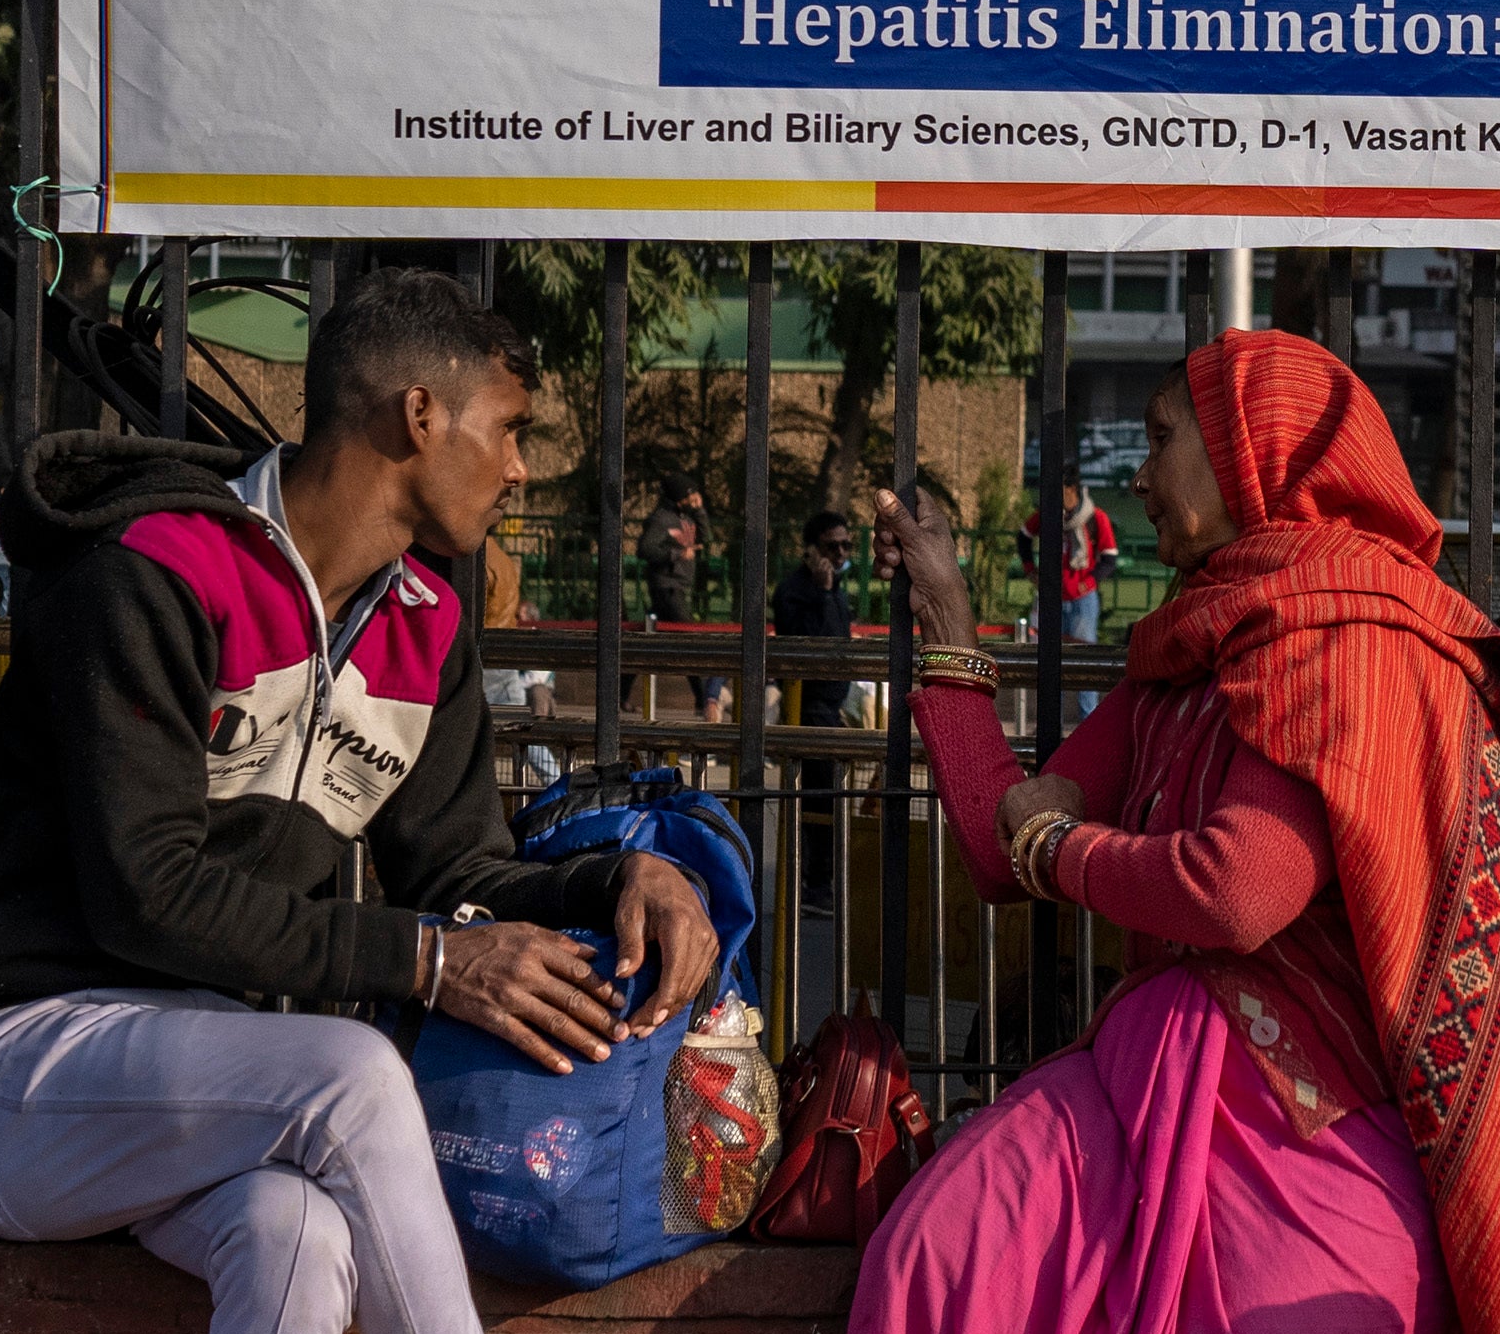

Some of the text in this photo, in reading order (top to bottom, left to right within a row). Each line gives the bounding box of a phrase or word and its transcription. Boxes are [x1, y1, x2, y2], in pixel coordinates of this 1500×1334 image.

[394, 108, 543, 142] Institute
[555, 110, 593, 142] of
[604, 111, 695, 143] Liver
[706, 112, 773, 144] and
[786, 113, 903, 153] Biliary
[914, 114, 1091, 153] Sciences,
[1103, 117, 1250, 156] GNCTD,
[1262, 120, 1331, 157] D-1,
[1343, 120, 1467, 154] Vasant
[208, 755, 268, 777] riginal
[322, 773, 361, 804] Brand
